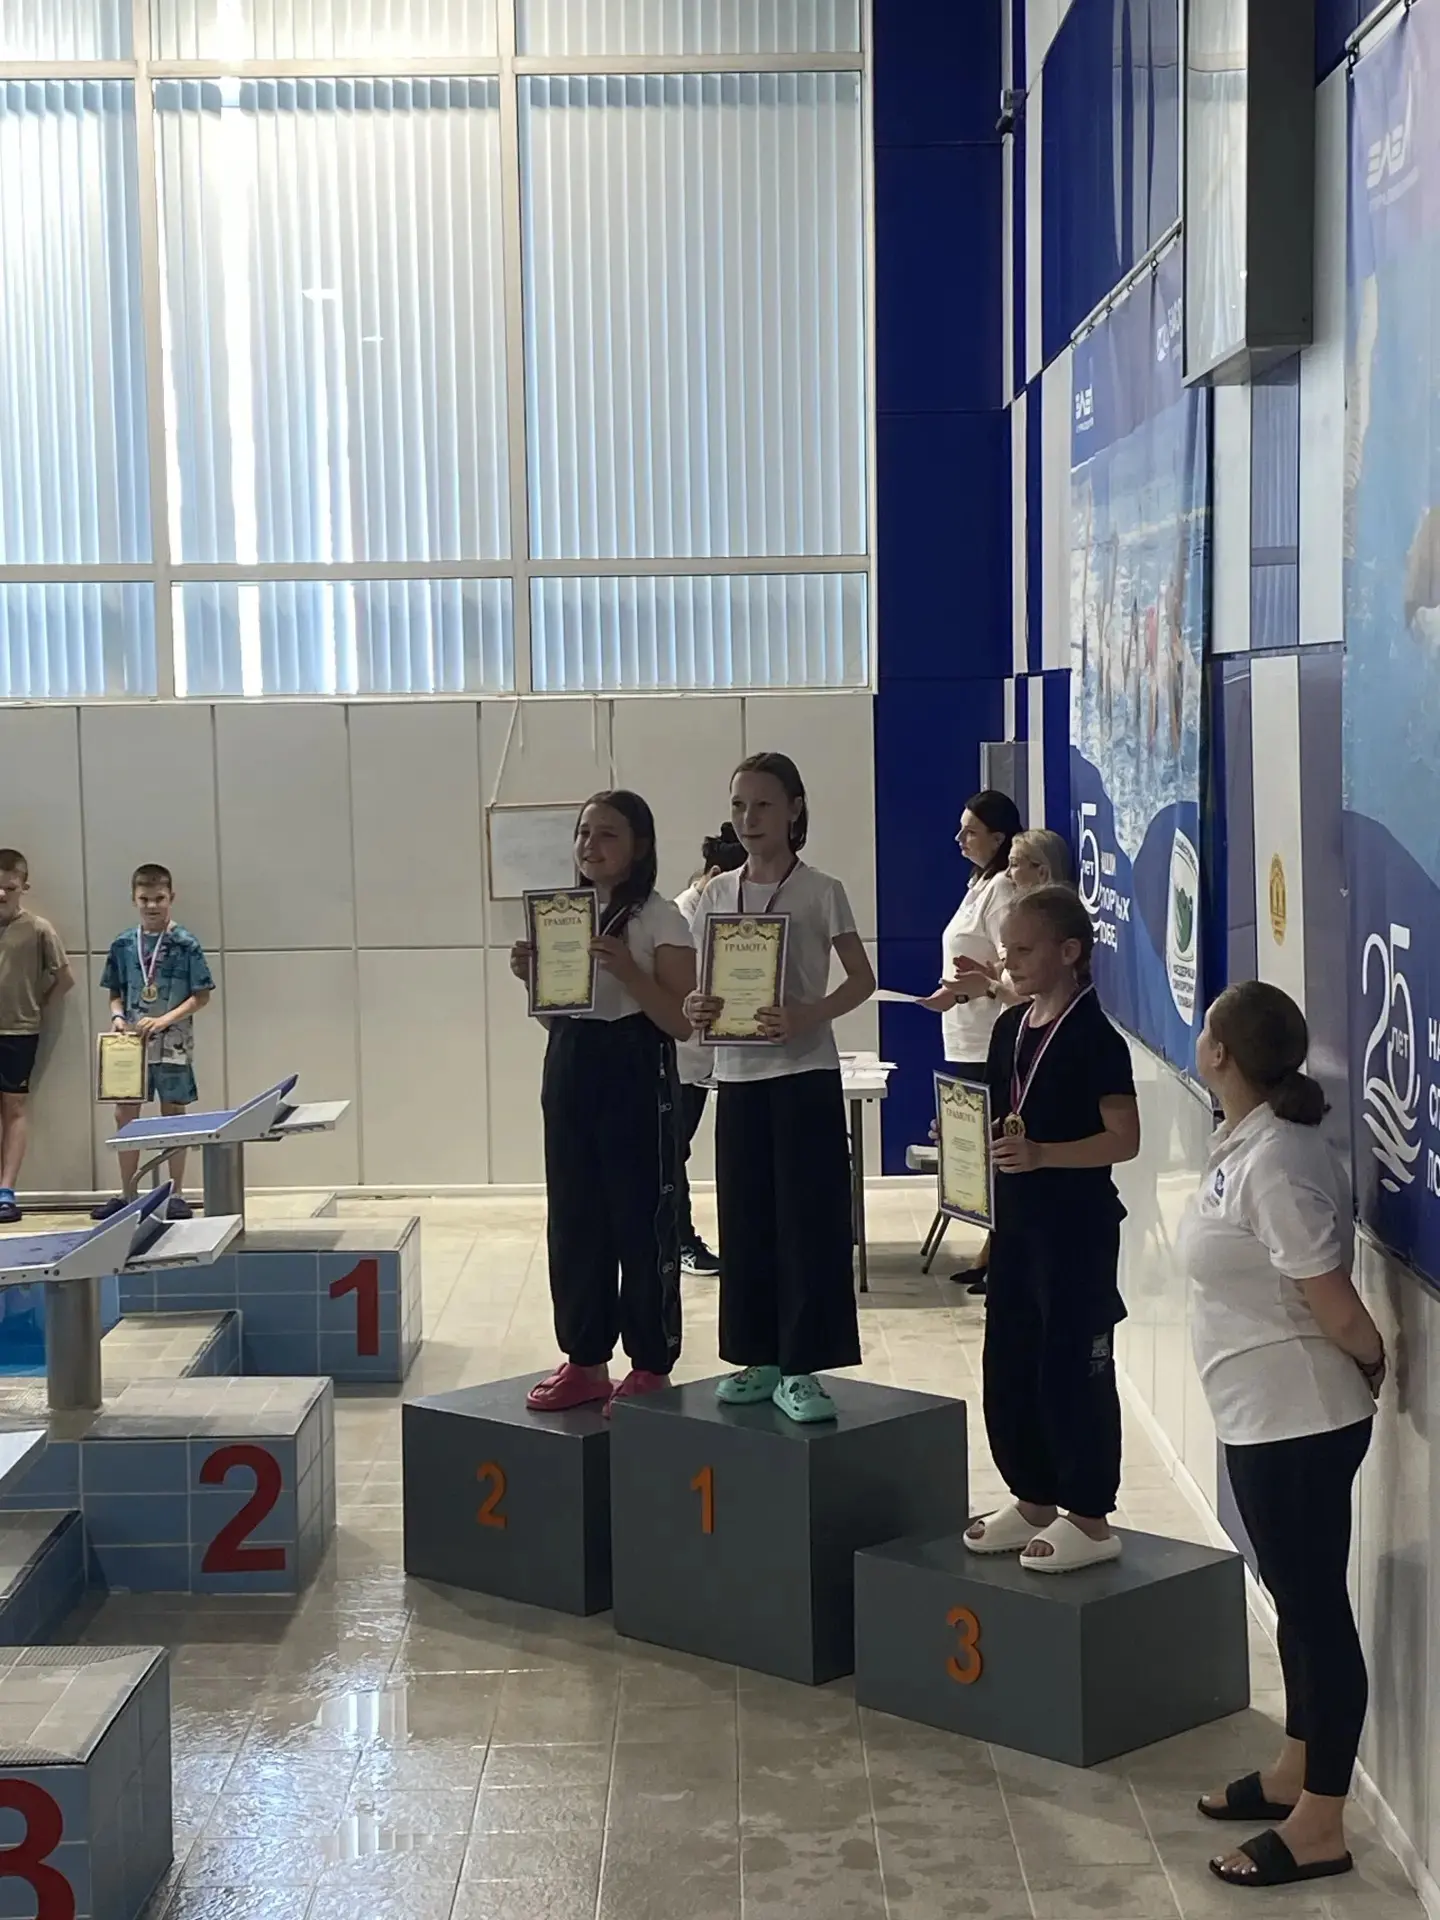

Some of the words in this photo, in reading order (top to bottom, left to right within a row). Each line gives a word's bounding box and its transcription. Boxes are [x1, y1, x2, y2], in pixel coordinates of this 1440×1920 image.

[724, 942, 768, 952] ГРАМОТА
[1362, 923, 1416, 1110] 25
[1390, 1026, 1409, 1059] лет
[328, 1258, 379, 1357] 1
[199, 1444, 286, 1573] 2
[476, 1462, 507, 1529] 2
[690, 1465, 714, 1535] 1
[945, 1605, 983, 1685] 3
